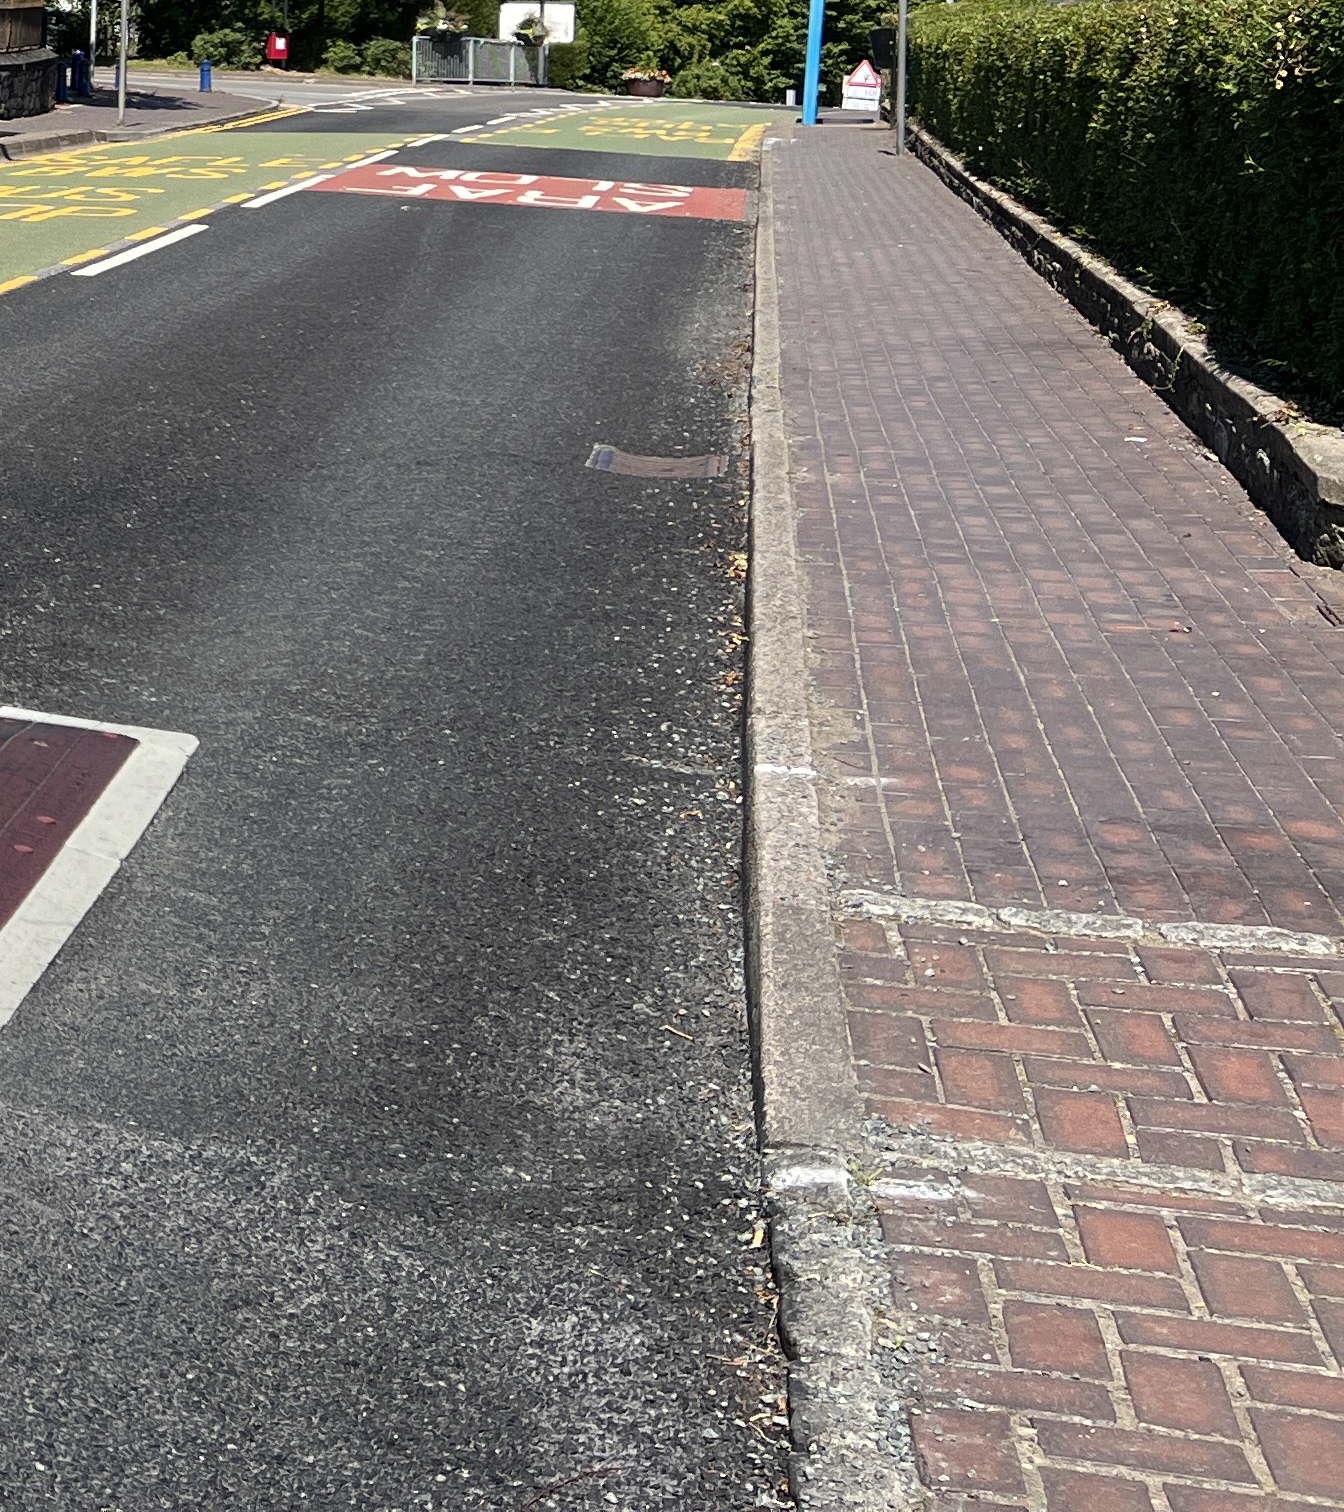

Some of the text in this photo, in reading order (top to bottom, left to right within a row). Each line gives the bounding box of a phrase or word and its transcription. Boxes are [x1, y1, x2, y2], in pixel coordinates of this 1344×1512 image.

[28, 154, 327, 168] SAFLE
[7, 165, 248, 180] BWS
[376, 166, 694, 198] SLOW
[343, 183, 686, 213] ARAF
